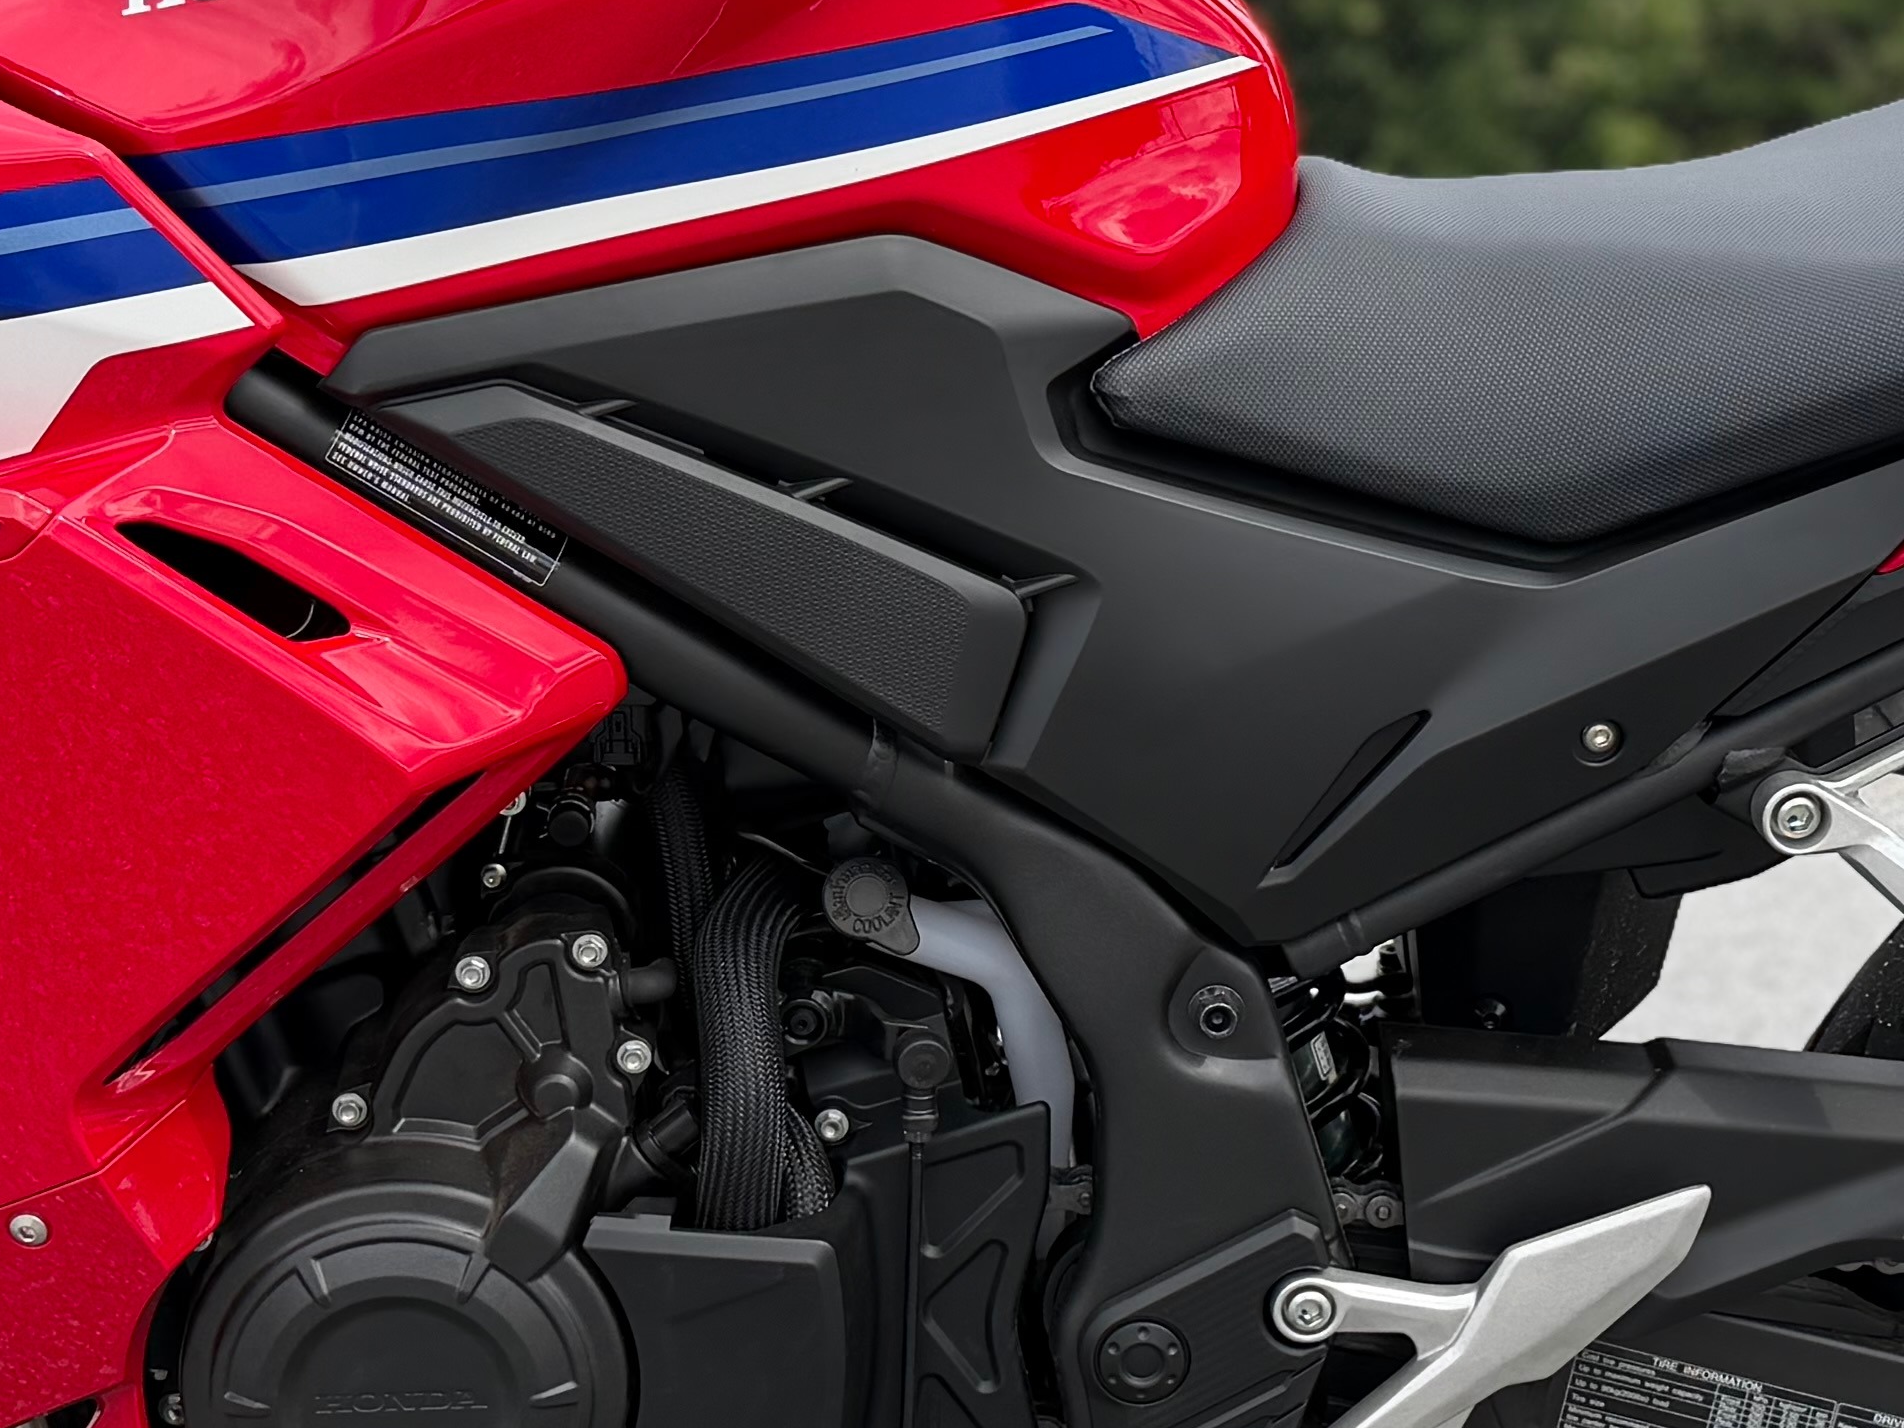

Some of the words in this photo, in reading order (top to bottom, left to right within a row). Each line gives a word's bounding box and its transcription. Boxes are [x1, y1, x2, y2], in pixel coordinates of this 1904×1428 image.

[1651, 1356, 1678, 1371] TIRE
[1683, 1364, 1763, 1393] INFORMATION
[315, 1390, 488, 1416] HONDA
